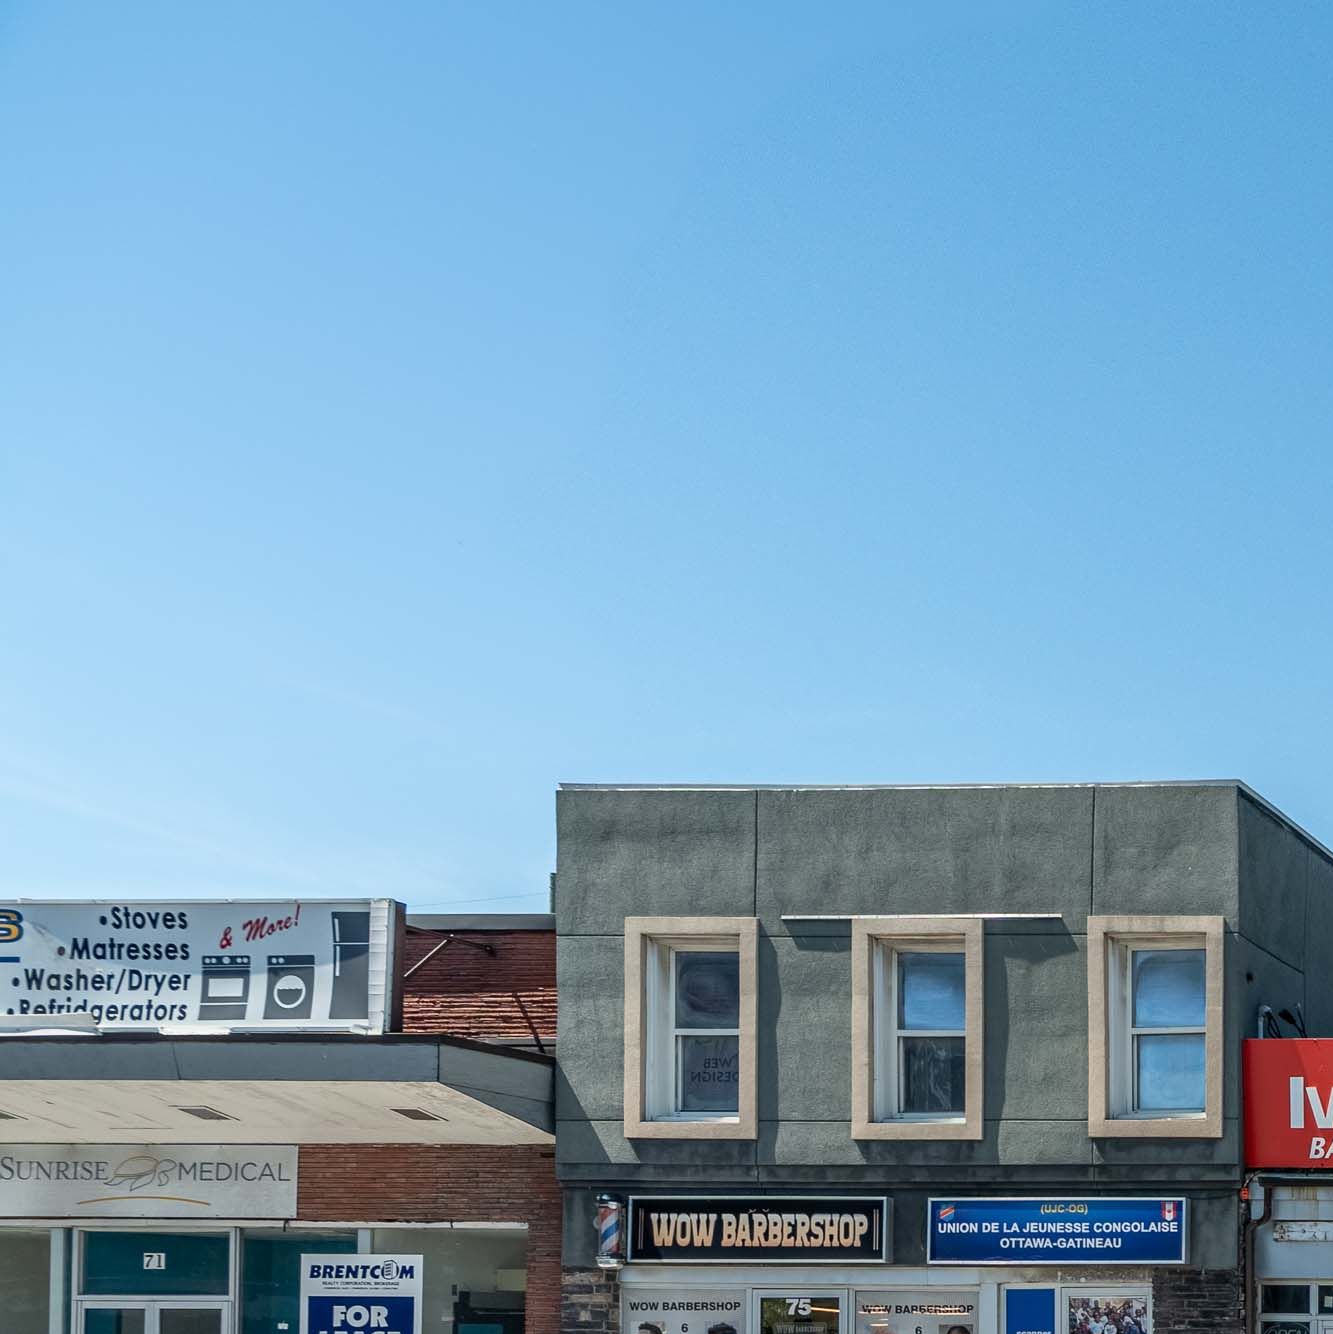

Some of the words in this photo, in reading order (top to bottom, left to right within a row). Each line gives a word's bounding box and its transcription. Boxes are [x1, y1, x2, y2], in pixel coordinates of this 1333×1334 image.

[110, 906, 189, 930] Stoves
[219, 926, 233, 949] &
[242, 904, 301, 942] More!
[69, 937, 191, 961] Matresses
[24, 968, 192, 995] Washer/Dryer
[0, 1156, 109, 1181] SUNRISE
[177, 1162, 291, 1182] MEDICAL
[1040, 1204, 1088, 1215] (UJC-OG)
[650, 1213, 717, 1248] WOW
[721, 1212, 869, 1248] BARBERSHOP
[938, 1221, 979, 1233] UNION
[982, 1222, 999, 1233] DE
[1003, 1222, 1019, 1233] LA
[1022, 1222, 1090, 1233] JEUNESSE
[1093, 1221, 1179, 1233] CONGOLAISE
[999, 1237, 1122, 1249] OTTAWA-GATINEAU
[144, 1254, 164, 1268] 71
[332, 1305, 389, 1328] FOR
[629, 1302, 658, 1311] WOW
[662, 1302, 741, 1311] BARBERSHOP
[786, 1298, 812, 1315] 75
[862, 1305, 892, 1314] WOW
